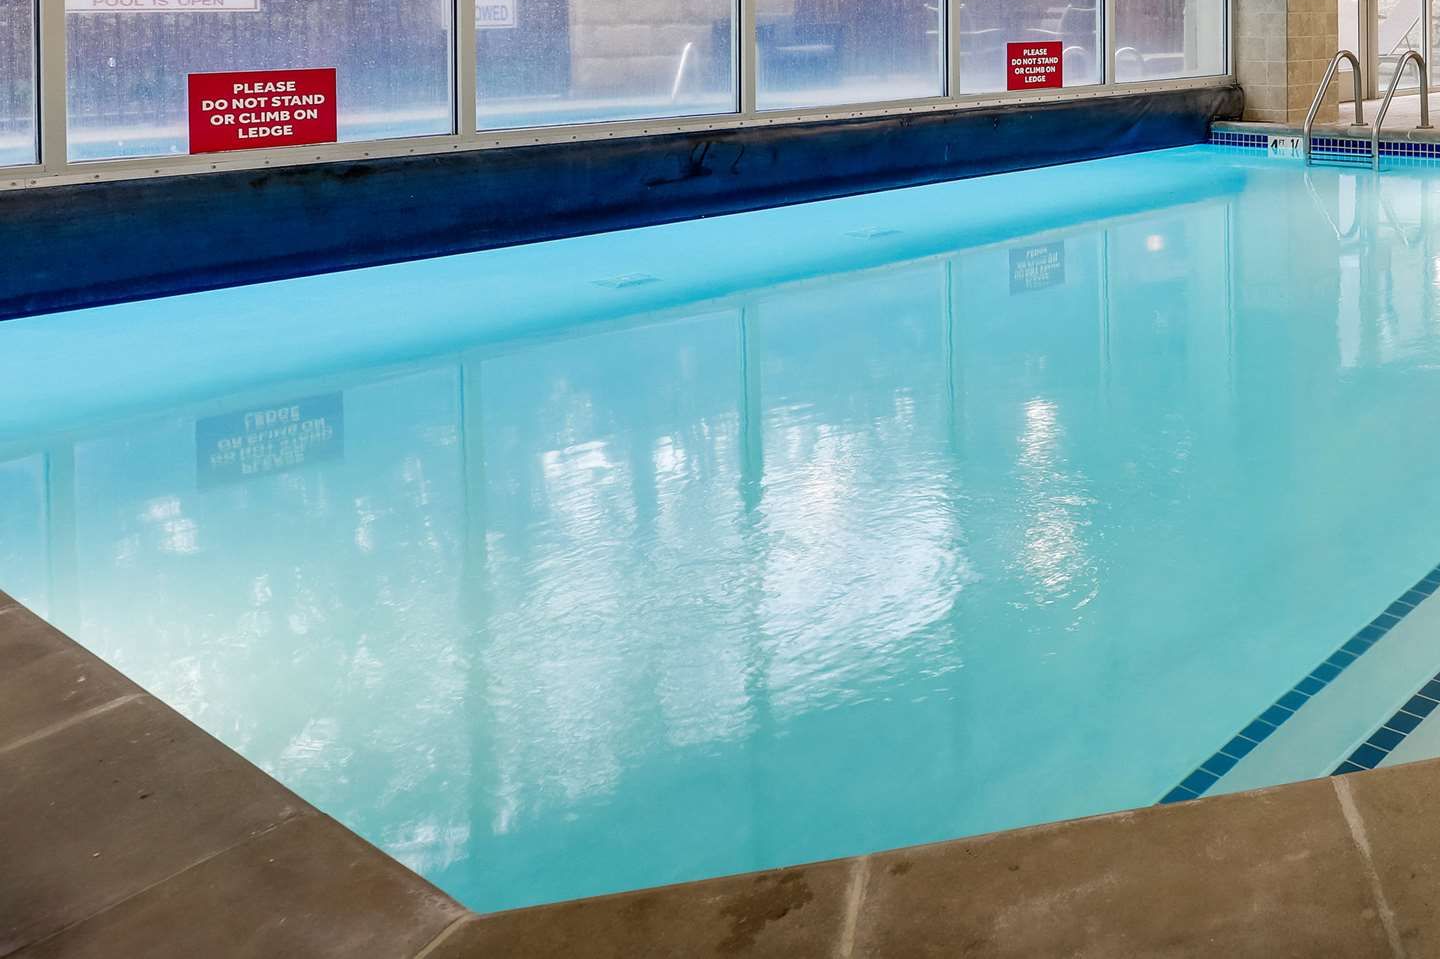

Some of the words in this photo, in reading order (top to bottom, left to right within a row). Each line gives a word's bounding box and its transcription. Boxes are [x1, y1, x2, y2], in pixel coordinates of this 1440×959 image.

[1023, 48, 1048, 56] PLEASE
[1011, 58, 1022, 66] DO
[1037, 57, 1059, 65] STAND
[1014, 67, 1025, 75] OR
[1025, 66, 1045, 74] CLIMB
[1025, 75, 1046, 83] LEDGE
[233, 81, 296, 95] PLEASE
[201, 99, 228, 112] DO
[232, 97, 268, 110] NOT
[271, 94, 326, 107] STAND
[210, 114, 235, 126] OR
[238, 111, 291, 124] CLIMB
[293, 109, 318, 120] ON
[238, 125, 293, 139] LEDGE
